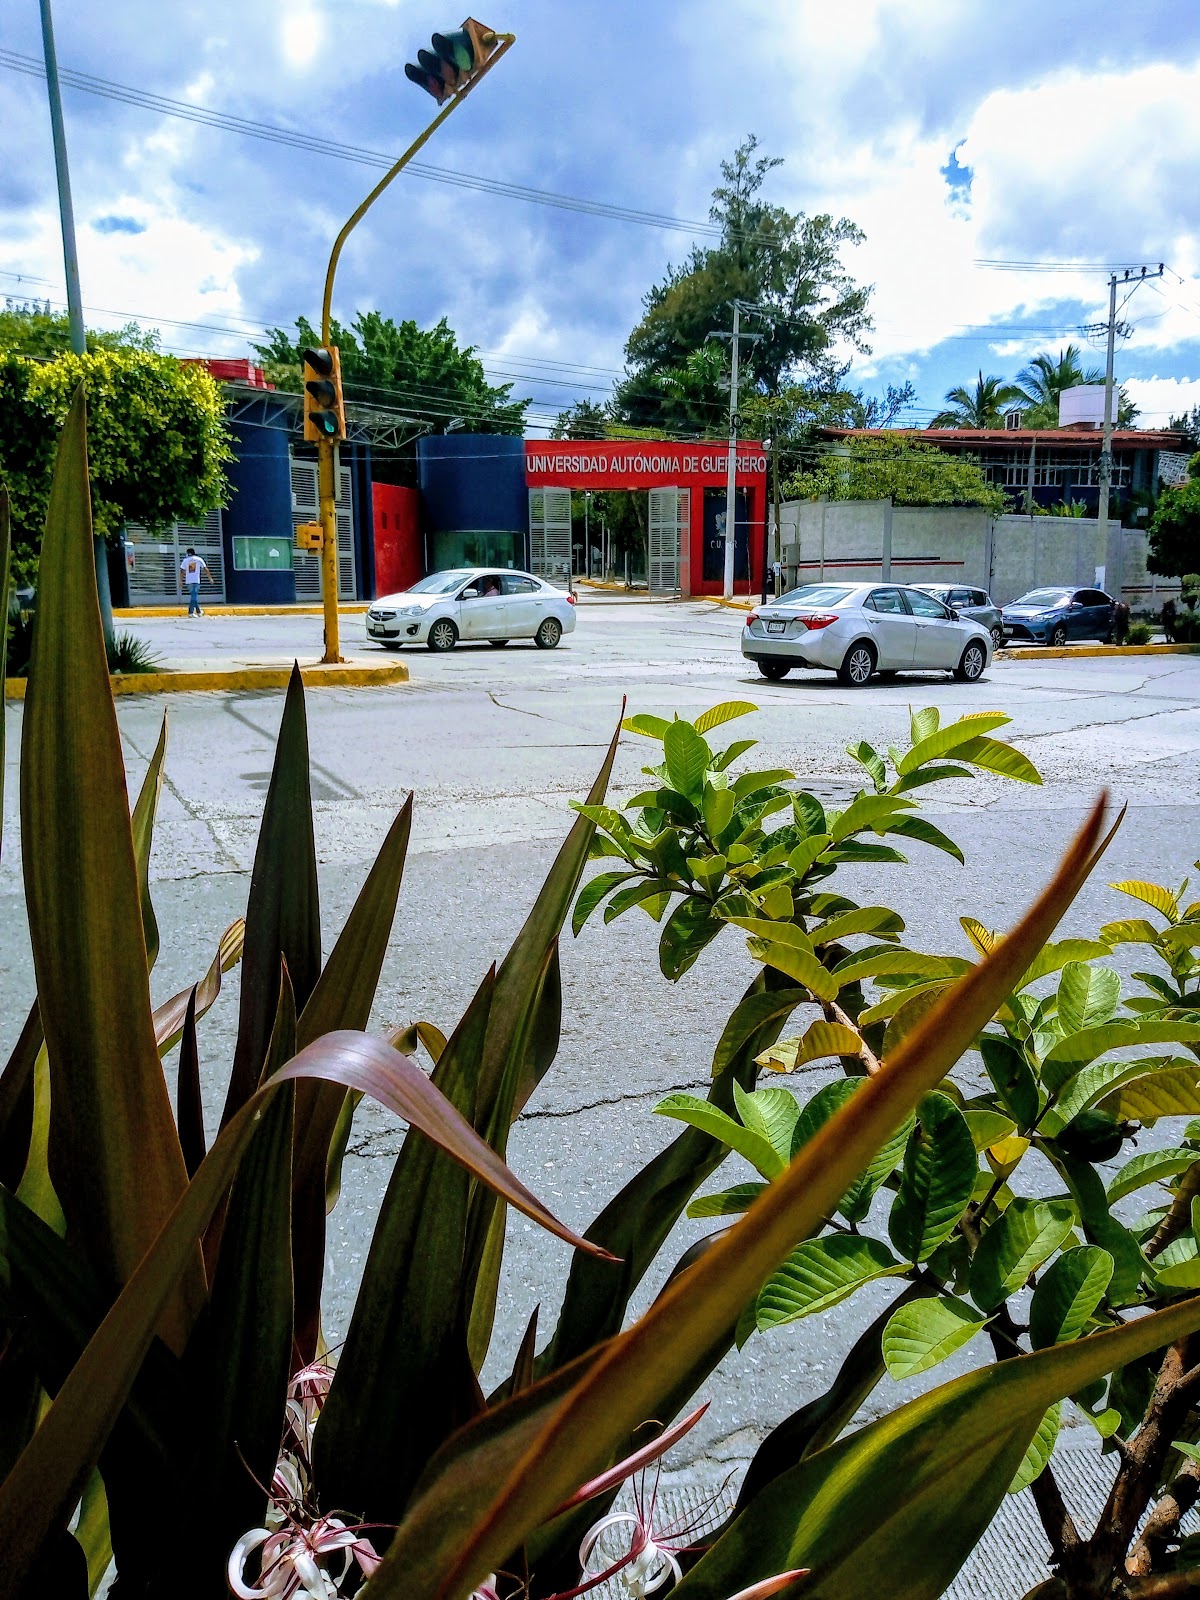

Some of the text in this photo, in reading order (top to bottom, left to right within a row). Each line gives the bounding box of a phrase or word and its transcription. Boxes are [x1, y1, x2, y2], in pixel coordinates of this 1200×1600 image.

[526, 455, 608, 473] UNIVERSIDAD
[609, 452, 681, 473] AUTÓNOMA
[682, 456, 699, 473] DE
